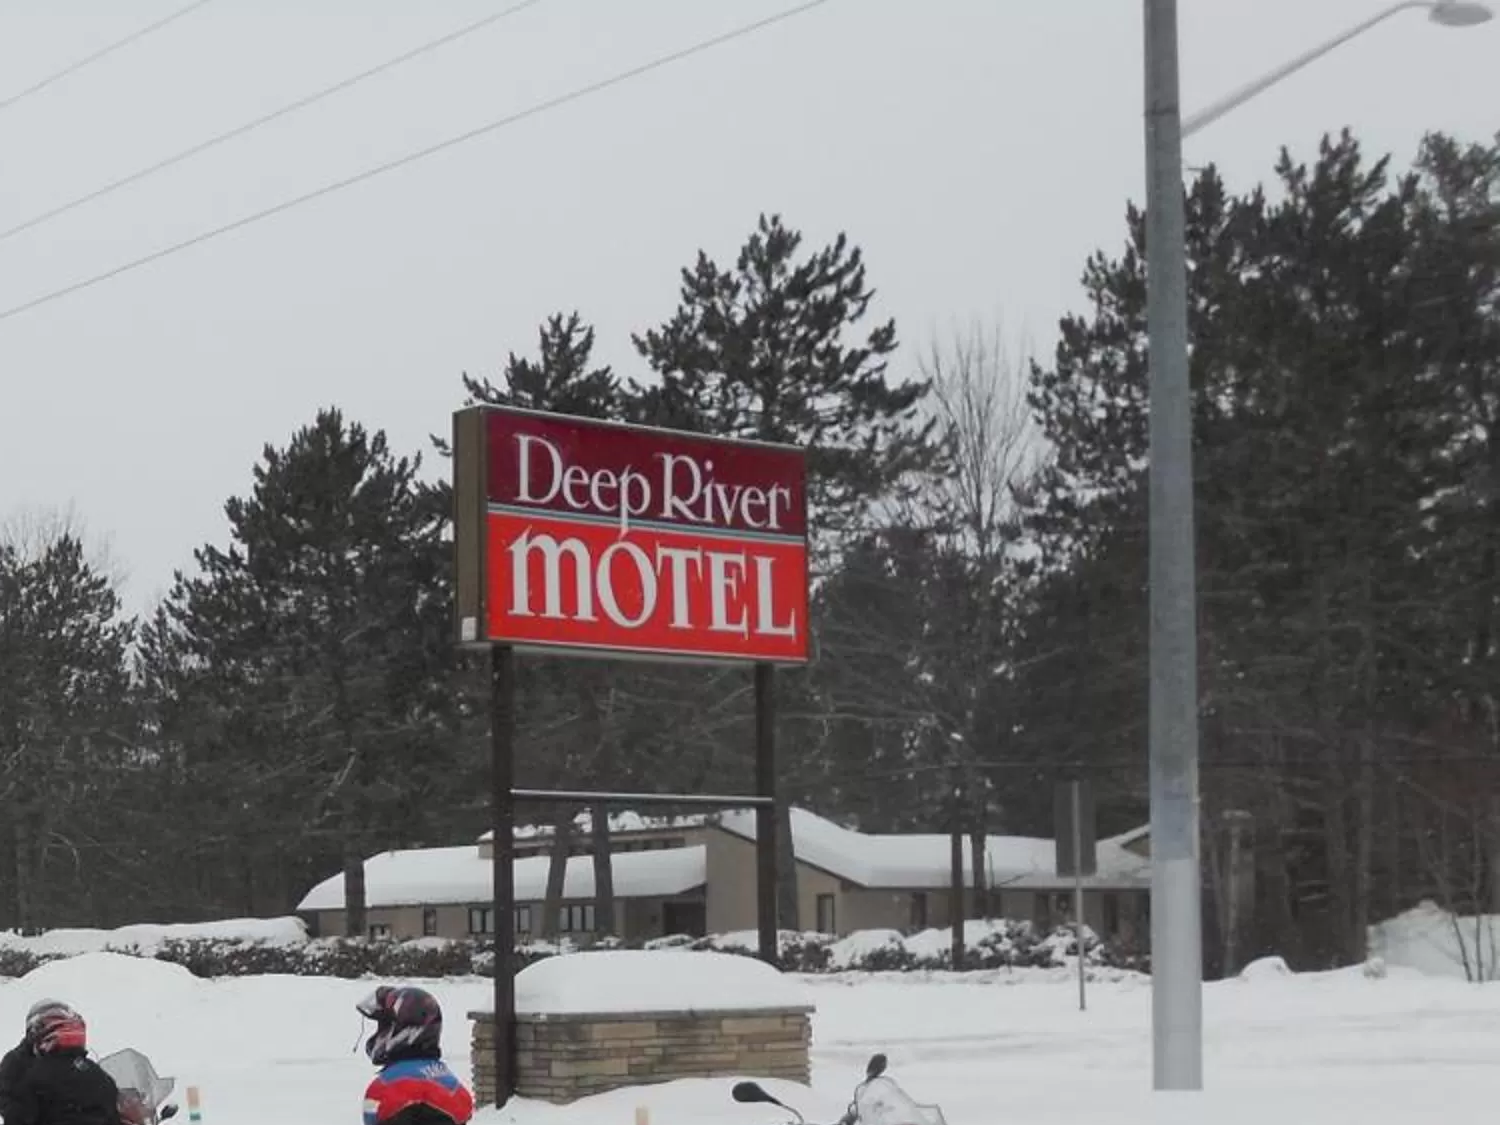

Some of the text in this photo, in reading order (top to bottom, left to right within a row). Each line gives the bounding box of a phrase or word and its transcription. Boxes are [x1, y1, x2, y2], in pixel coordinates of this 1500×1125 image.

[513, 433, 790, 540] Deep River
[507, 525, 797, 641] MOTEL
